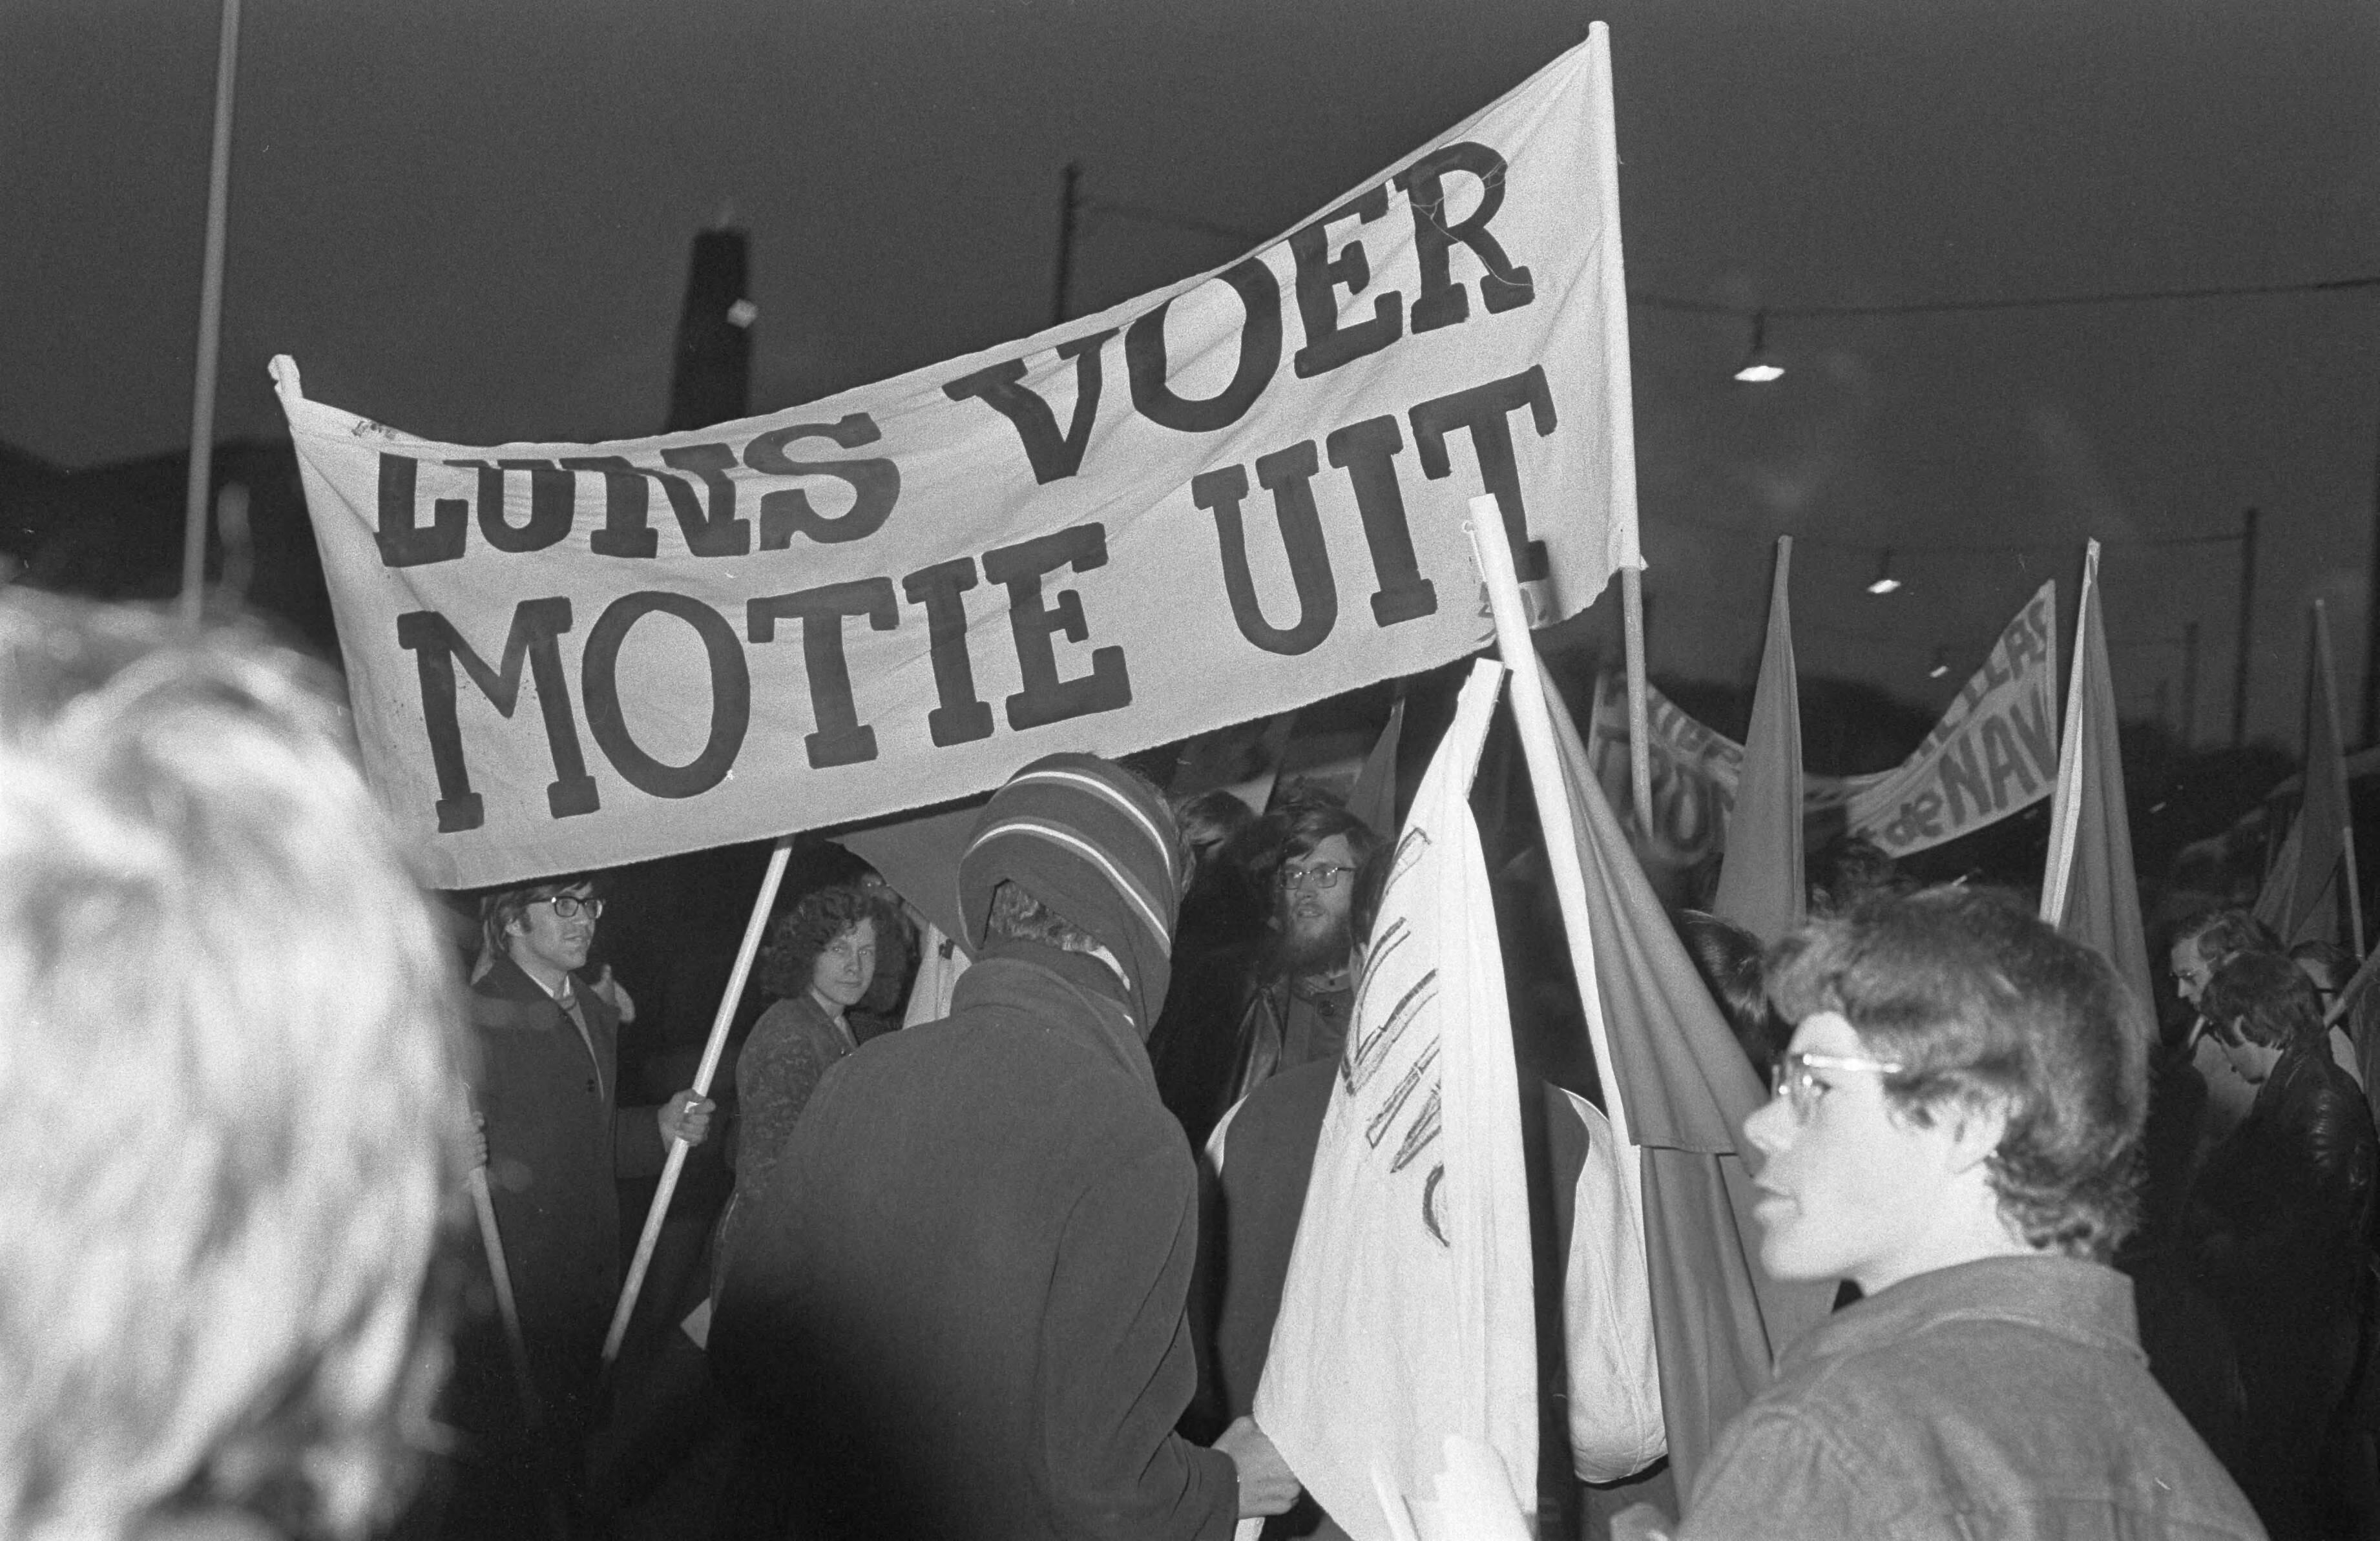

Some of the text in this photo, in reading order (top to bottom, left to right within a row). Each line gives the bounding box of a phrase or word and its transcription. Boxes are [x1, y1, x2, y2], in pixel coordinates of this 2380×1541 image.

[373, 141, 1535, 567] LUNS VOER
[397, 364, 1558, 833] MOTIE UIT
[1939, 686, 2060, 827] NAV
